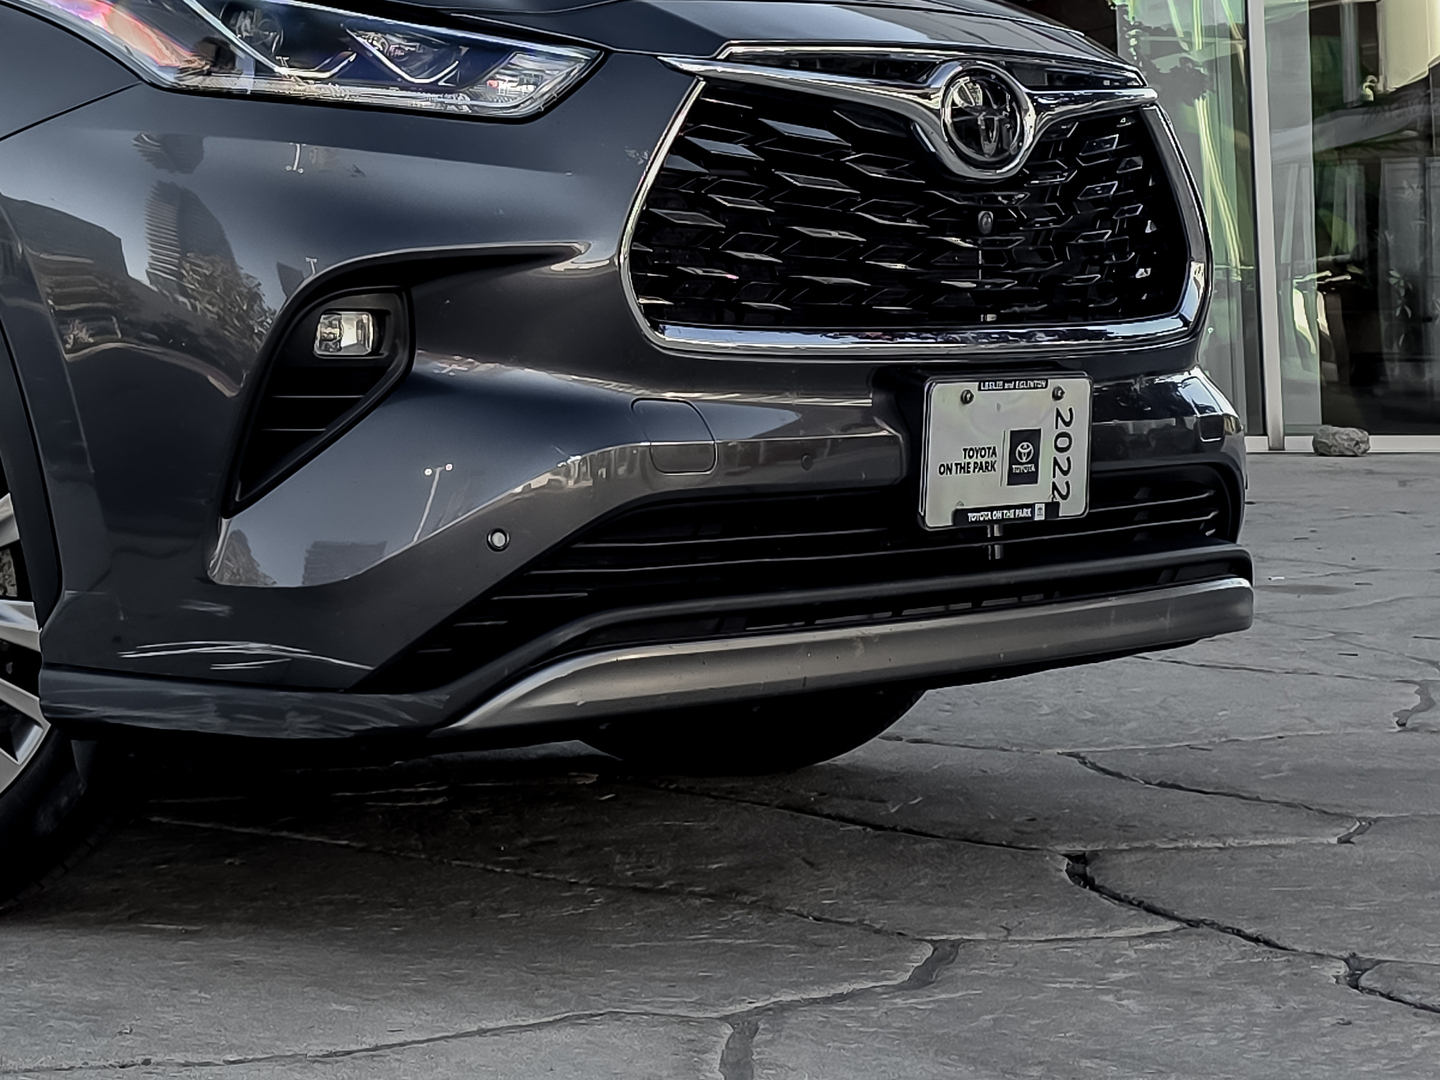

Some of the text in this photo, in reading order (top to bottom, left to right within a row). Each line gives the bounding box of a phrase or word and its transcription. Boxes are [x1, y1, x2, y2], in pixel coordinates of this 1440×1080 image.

[963, 446, 997, 460] TOYOTA
[1052, 407, 1074, 501] 2022
[939, 460, 997, 475] ON THE PARK
[967, 511, 992, 522] TOYOTA
[992, 510, 1003, 519] ON
[1015, 508, 1032, 517] PARK
